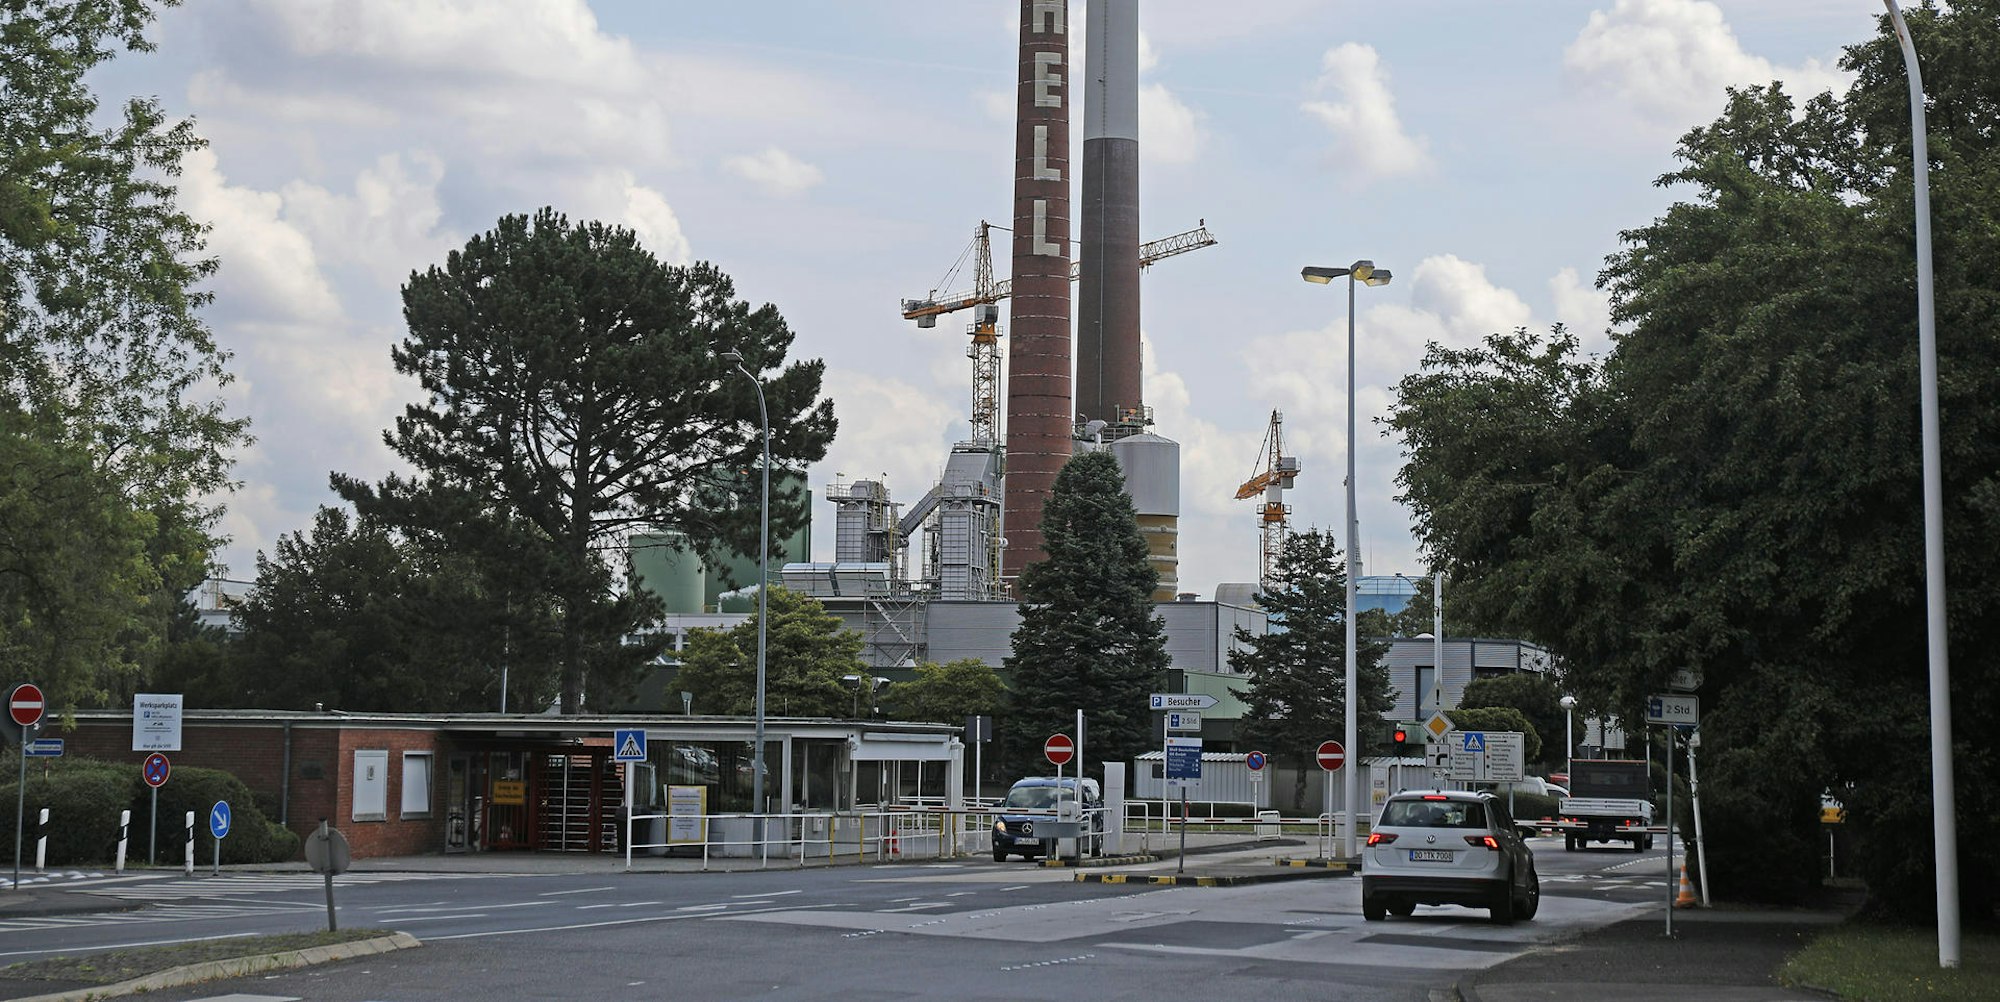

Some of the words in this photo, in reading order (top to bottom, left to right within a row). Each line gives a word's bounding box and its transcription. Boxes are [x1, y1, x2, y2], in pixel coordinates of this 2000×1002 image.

[139, 702, 177, 710] Werksparkplatz
[1168, 697, 1201, 706] Besucher
[1666, 705, 1673, 714] 2
